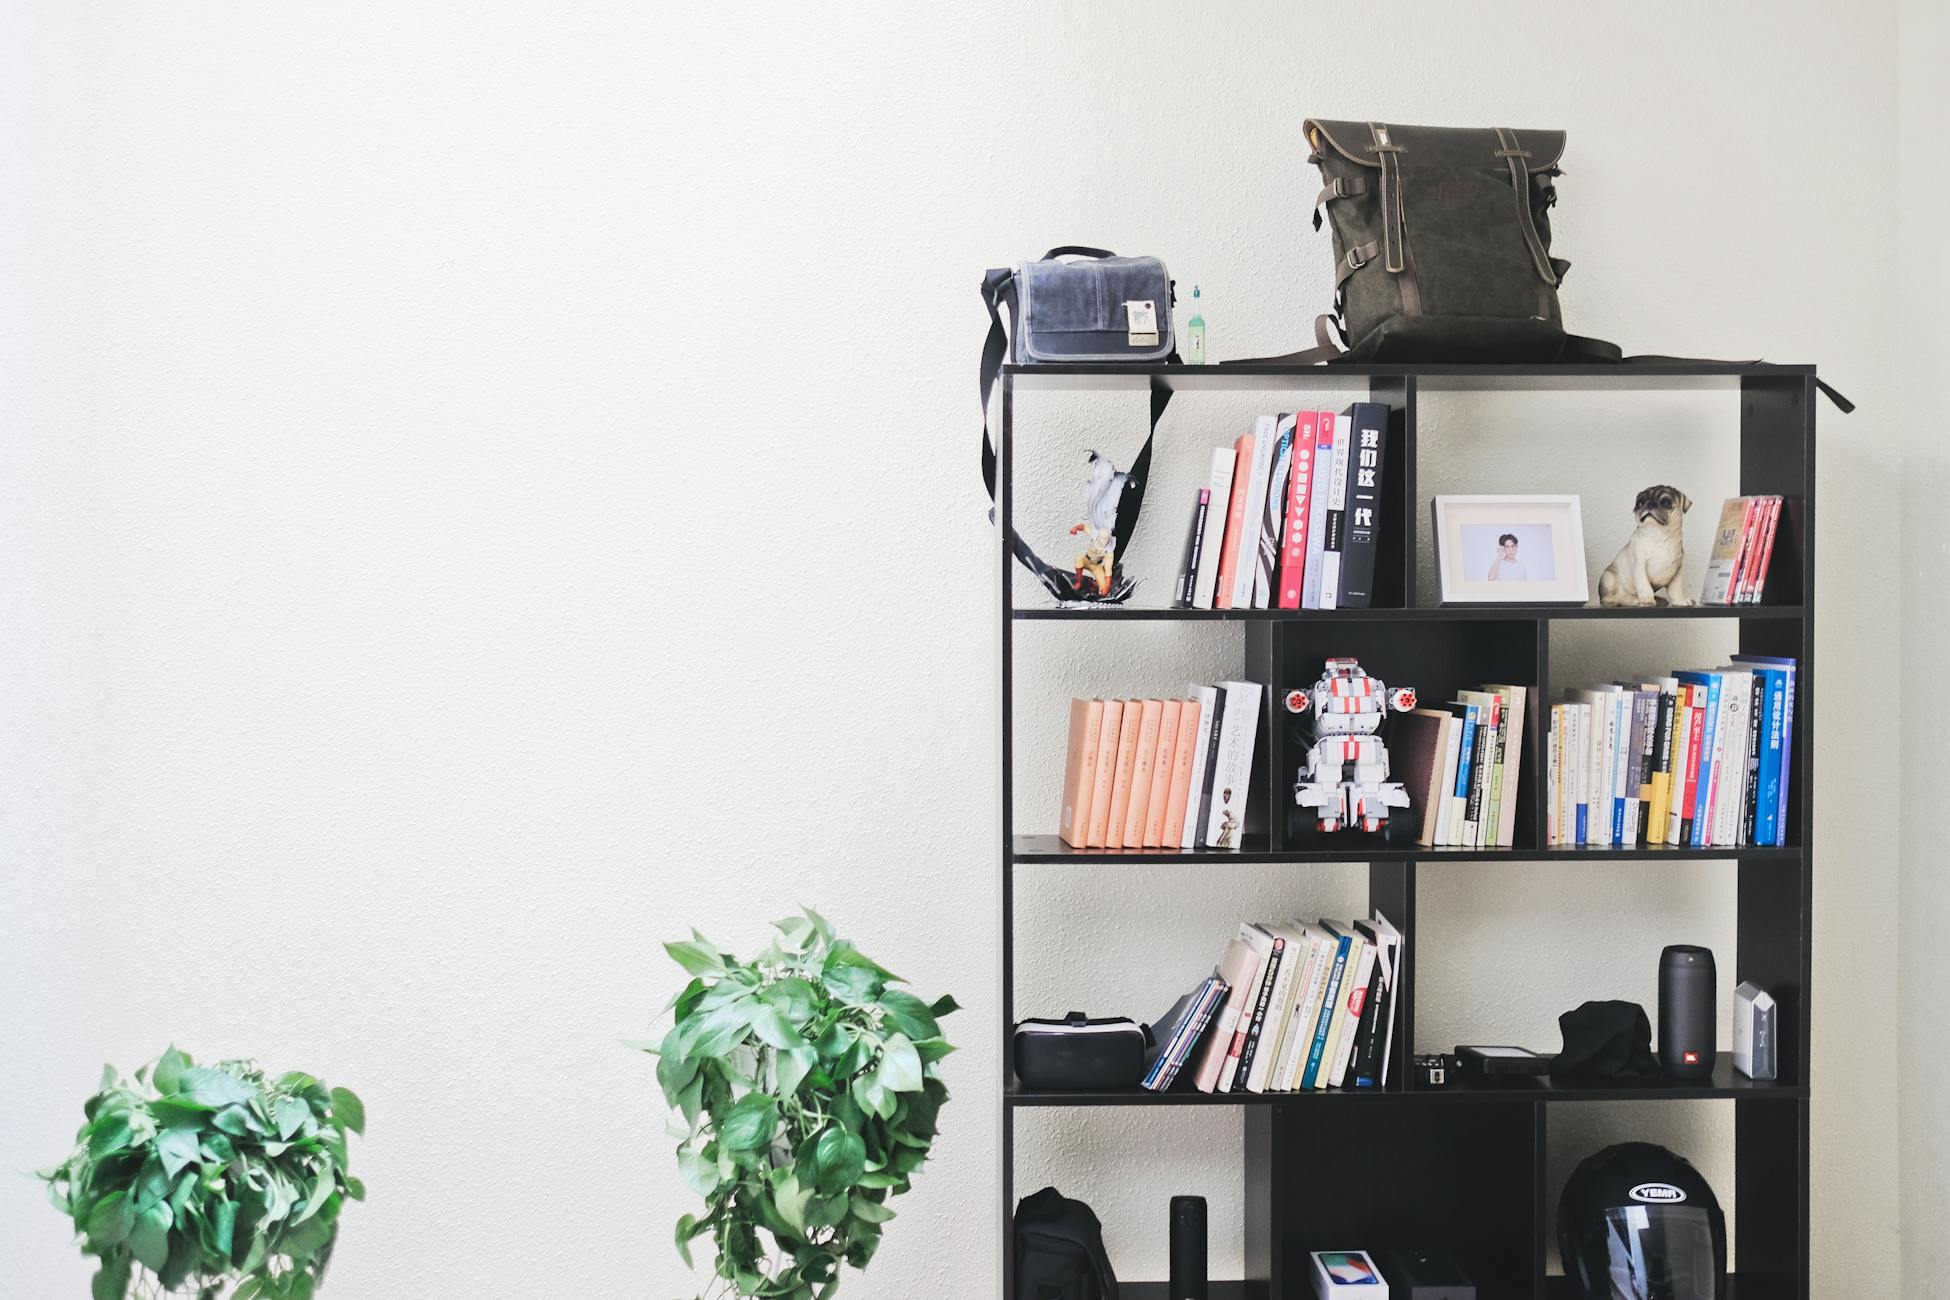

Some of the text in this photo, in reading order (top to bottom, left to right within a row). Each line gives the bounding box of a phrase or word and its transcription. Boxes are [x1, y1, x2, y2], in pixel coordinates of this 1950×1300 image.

[1354, 429, 1379, 527] 我们这一代
